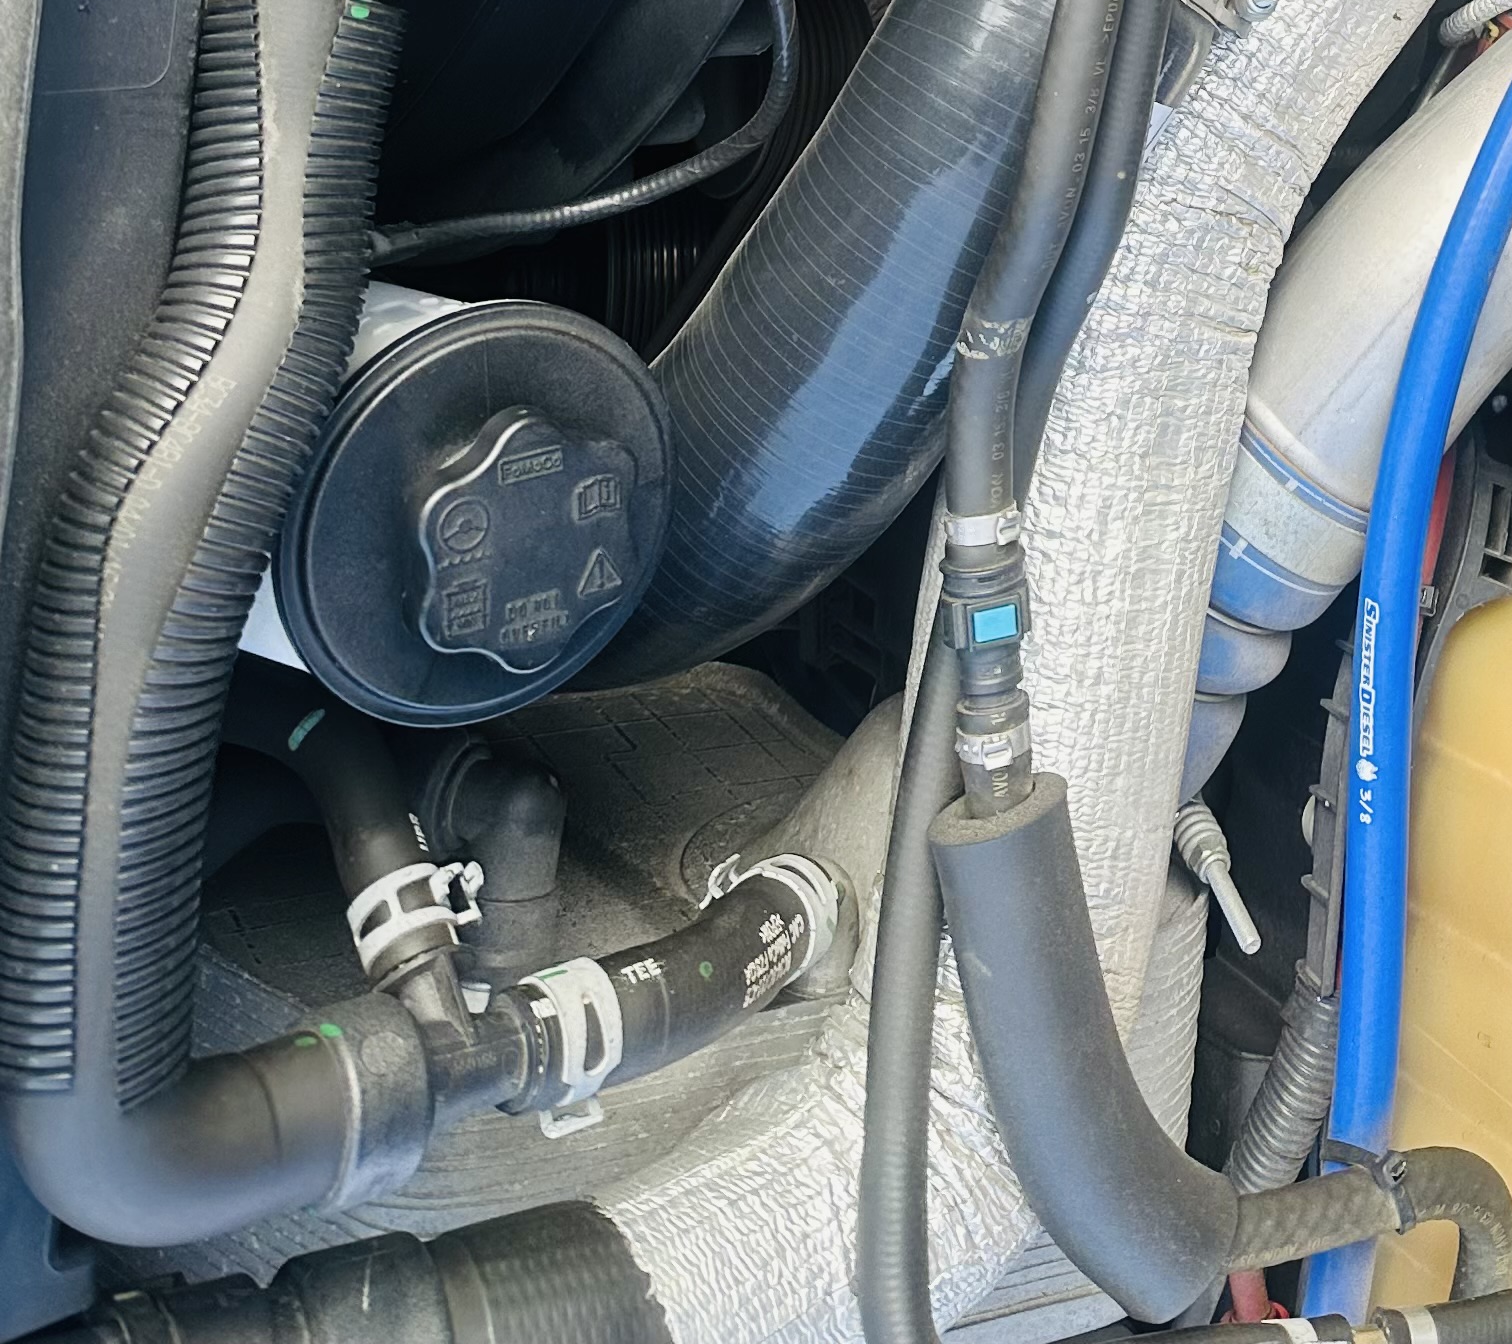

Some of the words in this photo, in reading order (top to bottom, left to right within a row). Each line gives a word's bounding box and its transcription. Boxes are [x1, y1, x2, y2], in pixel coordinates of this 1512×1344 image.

[1077, 126, 1092, 146] 15
[1071, 151, 1087, 173] 03
[990, 441, 1006, 461] 03
[502, 451, 563, 480] FoMoCo
[1359, 788, 1373, 825] 3/8
[621, 958, 662, 984] TEE
